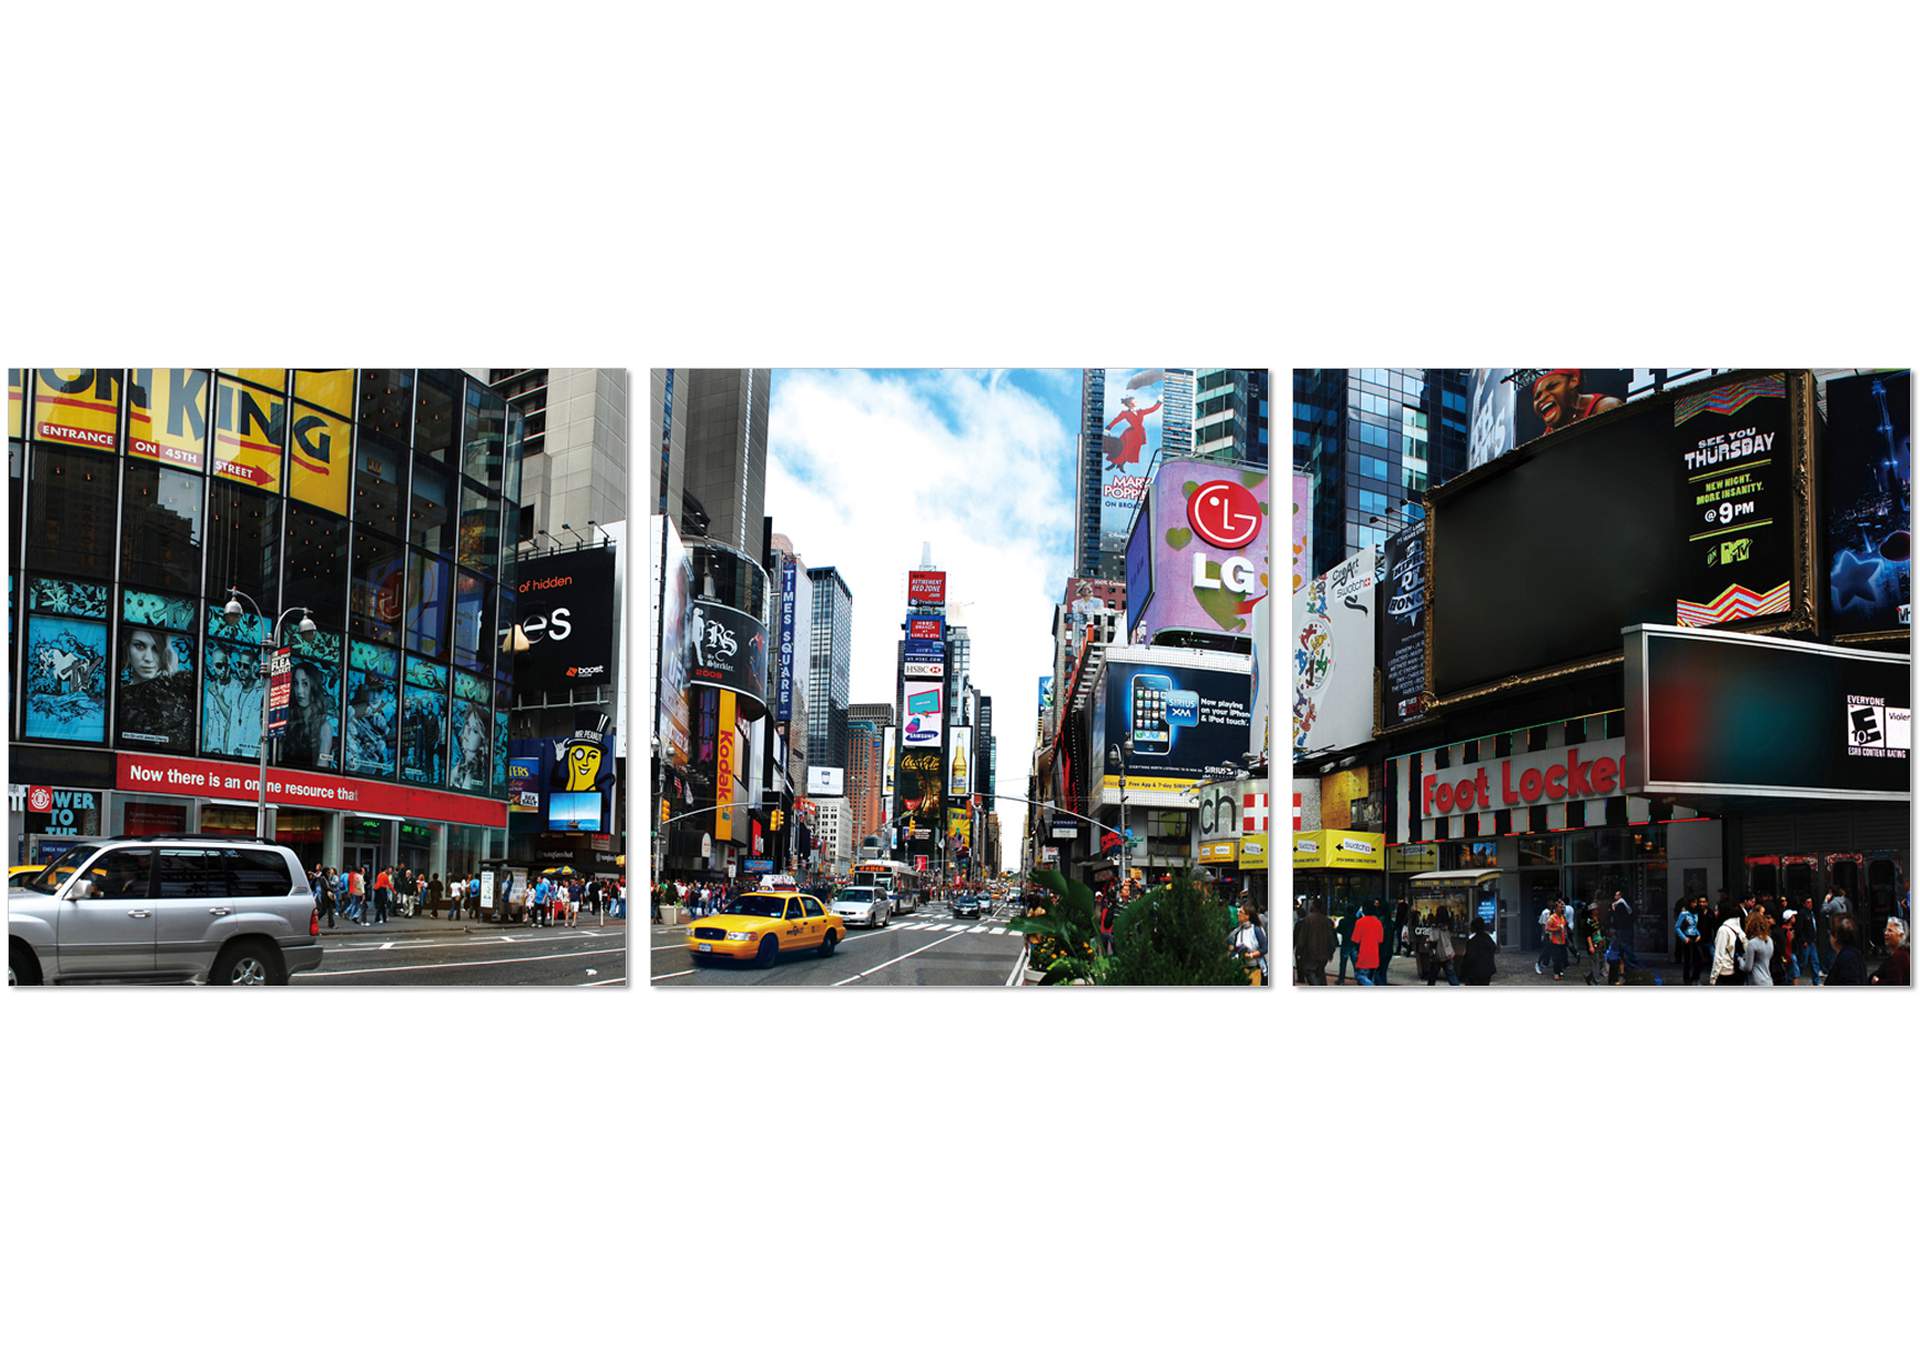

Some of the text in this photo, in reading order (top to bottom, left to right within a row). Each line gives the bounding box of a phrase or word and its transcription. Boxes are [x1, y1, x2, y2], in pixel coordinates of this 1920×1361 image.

[167, 369, 331, 464] KING
[1698, 427, 1756, 449] SEE YOU
[42, 425, 253, 478] ENTRANCE ON 45TH STREET
[1684, 432, 1776, 470] THURSDAY
[1113, 475, 1151, 489] MARY
[1705, 478, 1722, 492] NEW
[1696, 493, 1721, 506] MORE
[1192, 552, 1255, 594] LG
[518, 575, 573, 593] of hidden
[780, 570, 795, 703] TIMES SQUARE
[578, 665, 603, 674] boost
[906, 665, 929, 673] HSBC
[1168, 698, 1196, 708] SIRIUS
[1200, 698, 1243, 710] Now playing
[1847, 694, 1885, 706] EVERYONE
[1172, 709, 1192, 718] XM
[1208, 716, 1225, 724] iPod
[1863, 747, 1885, 757] CONTENT
[1887, 748, 1906, 758] RATING
[718, 729, 733, 800] Kodak
[130, 764, 163, 782] Now
[167, 769, 204, 786] there
[208, 772, 220, 787] is
[224, 777, 241, 789] an
[285, 782, 334, 799] resource
[1423, 767, 1490, 816] Foot
[51, 809, 74, 826] TO
[1201, 788, 1237, 834] ch
